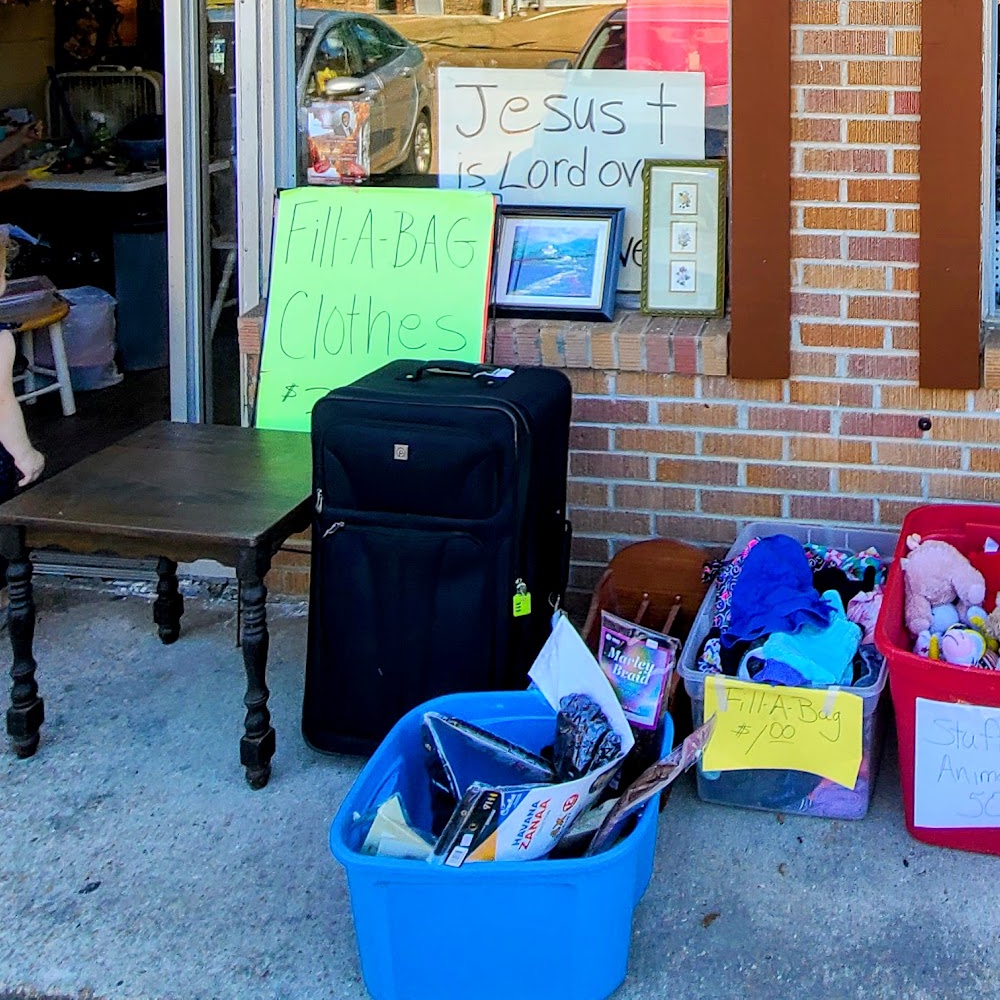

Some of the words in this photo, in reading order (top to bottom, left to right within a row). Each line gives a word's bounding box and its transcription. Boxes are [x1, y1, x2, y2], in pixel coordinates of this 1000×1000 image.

[455, 83, 626, 138] Jesus
[498, 147, 588, 190] Lord
[279, 290, 468, 359] Clothes
[607, 646, 656, 674] Marley
[612, 663, 652, 685] Braid
[512, 800, 540, 846] HAVANA
